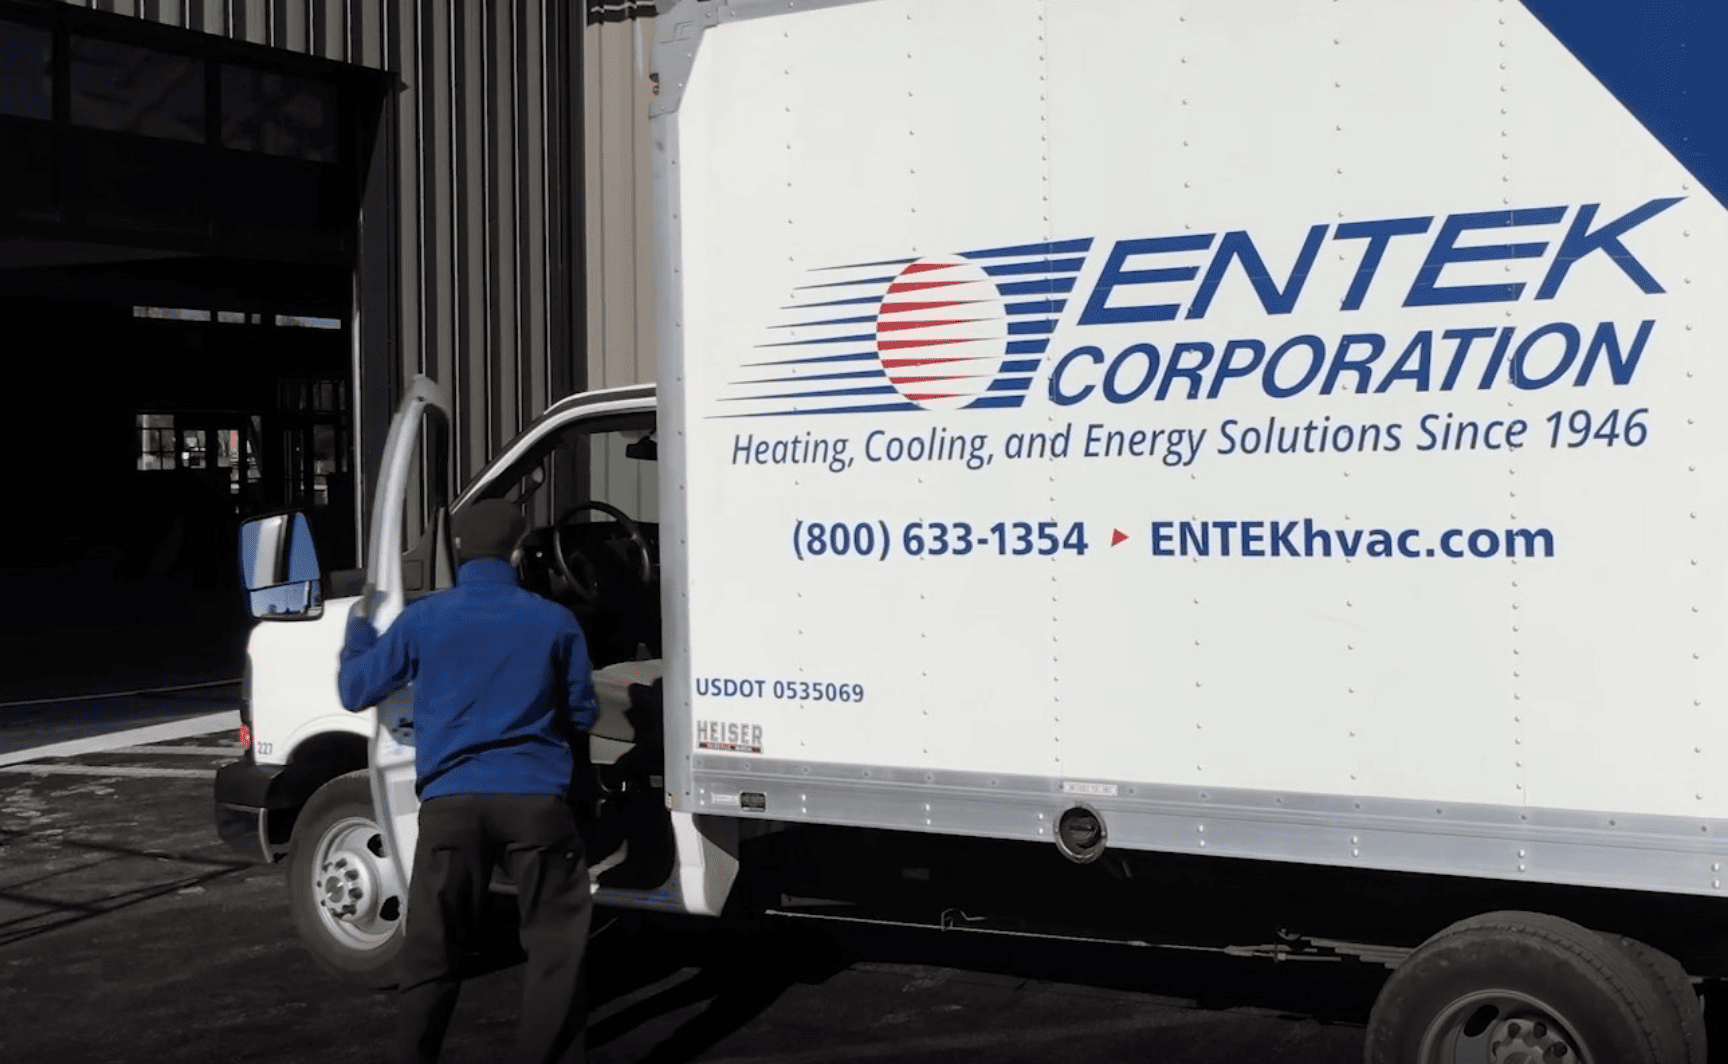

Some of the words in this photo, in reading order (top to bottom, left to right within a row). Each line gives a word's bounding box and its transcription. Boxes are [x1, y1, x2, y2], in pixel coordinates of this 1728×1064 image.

[1076, 196, 1688, 327] ENTEK
[1047, 319, 1657, 407] CORPORATION
[731, 432, 855, 474] Heating,
[865, 427, 994, 471] Cooling,
[1004, 422, 1073, 460] and
[1083, 423, 1208, 467] Energy
[1217, 416, 1404, 456] Solutions
[1416, 413, 1529, 453] Since
[1546, 407, 1650, 449] 1946
[793, 520, 891, 561] (800)
[902, 521, 1090, 557] 633-1354
[1150, 517, 1556, 559] ENTEKhvac.com
[696, 678, 766, 698] USDOT
[773, 680, 864, 703] 0535069
[696, 720, 763, 745] HEISER
